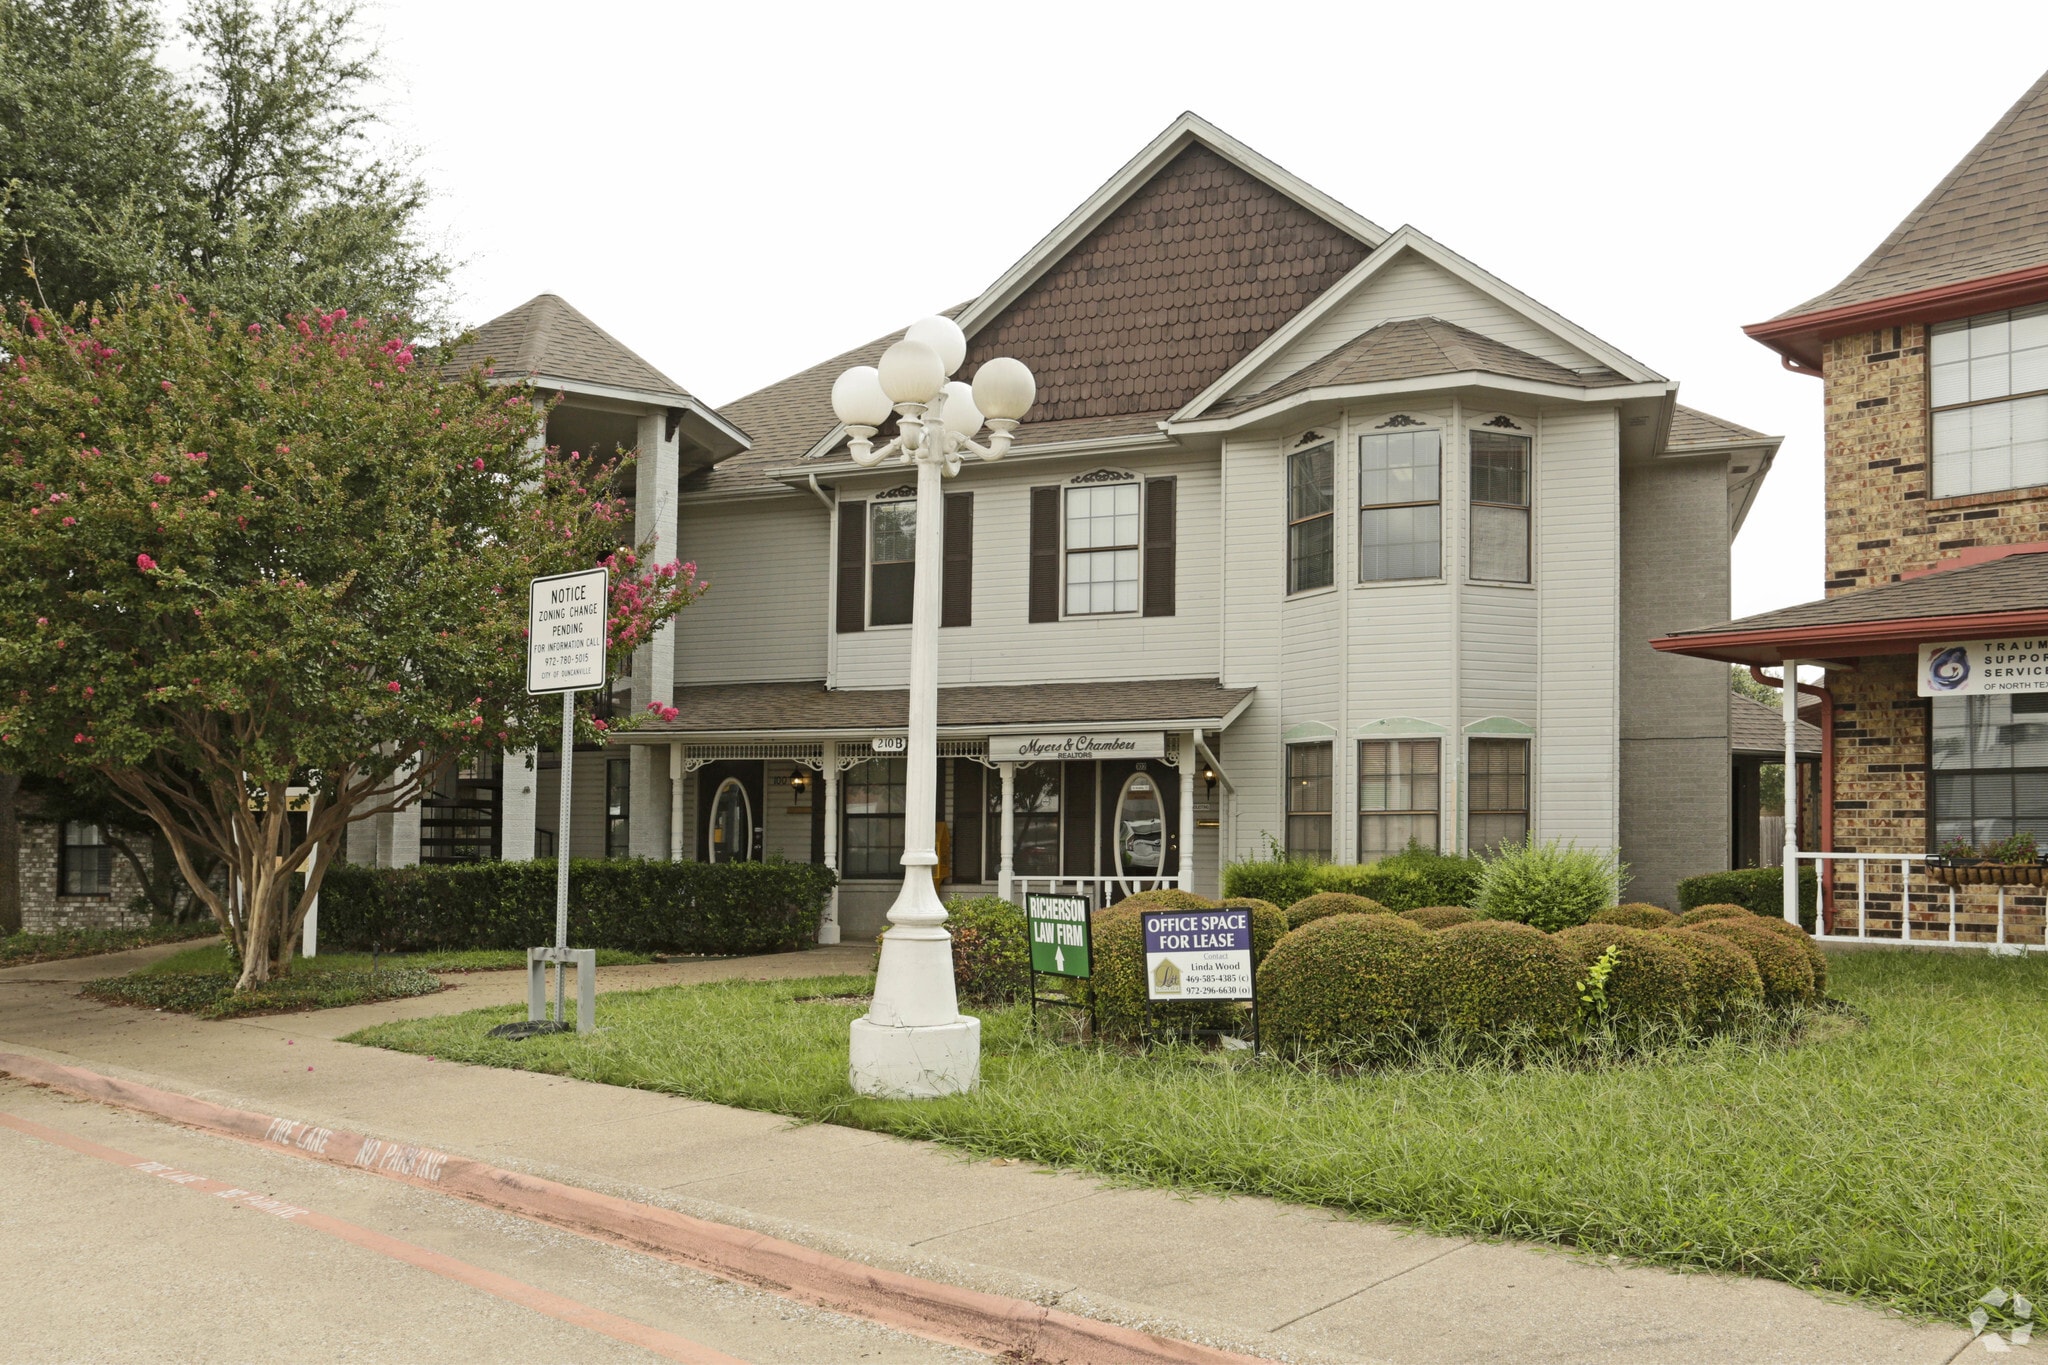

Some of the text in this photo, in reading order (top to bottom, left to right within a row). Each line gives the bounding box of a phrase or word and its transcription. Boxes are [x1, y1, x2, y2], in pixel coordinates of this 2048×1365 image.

[551, 585, 587, 604] NOTICE
[538, 603, 598, 622] ZONING CHANGE
[552, 622, 584, 636] PENDING
[533, 637, 600, 654] FOR INFORMATION CALL
[1984, 640, 2048, 652] TRAUM
[544, 653, 589, 667] 972-780-5015
[541, 667, 592, 680] CITY OF DUNCANVILLE
[1999, 682, 2031, 690] NORTH
[1018, 735, 1136, 756] Myers & Chambers
[1057, 751, 1093, 759] REALTORS
[1030, 897, 1086, 922] RICHERSON
[1147, 914, 1247, 933] OFFICE SPACE
[1034, 921, 1084, 947] LAW FIRM
[1159, 933, 1235, 949] FOR LEASE
[1203, 952, 1229, 960] Contact
[1191, 962, 1241, 971] Linda Wood
[1185, 974, 1238, 983] 469-585-4385
[1186, 986, 1238, 995] 972-296-6630
[264, 1117, 448, 1182] FIRE LANE NO PARKING
